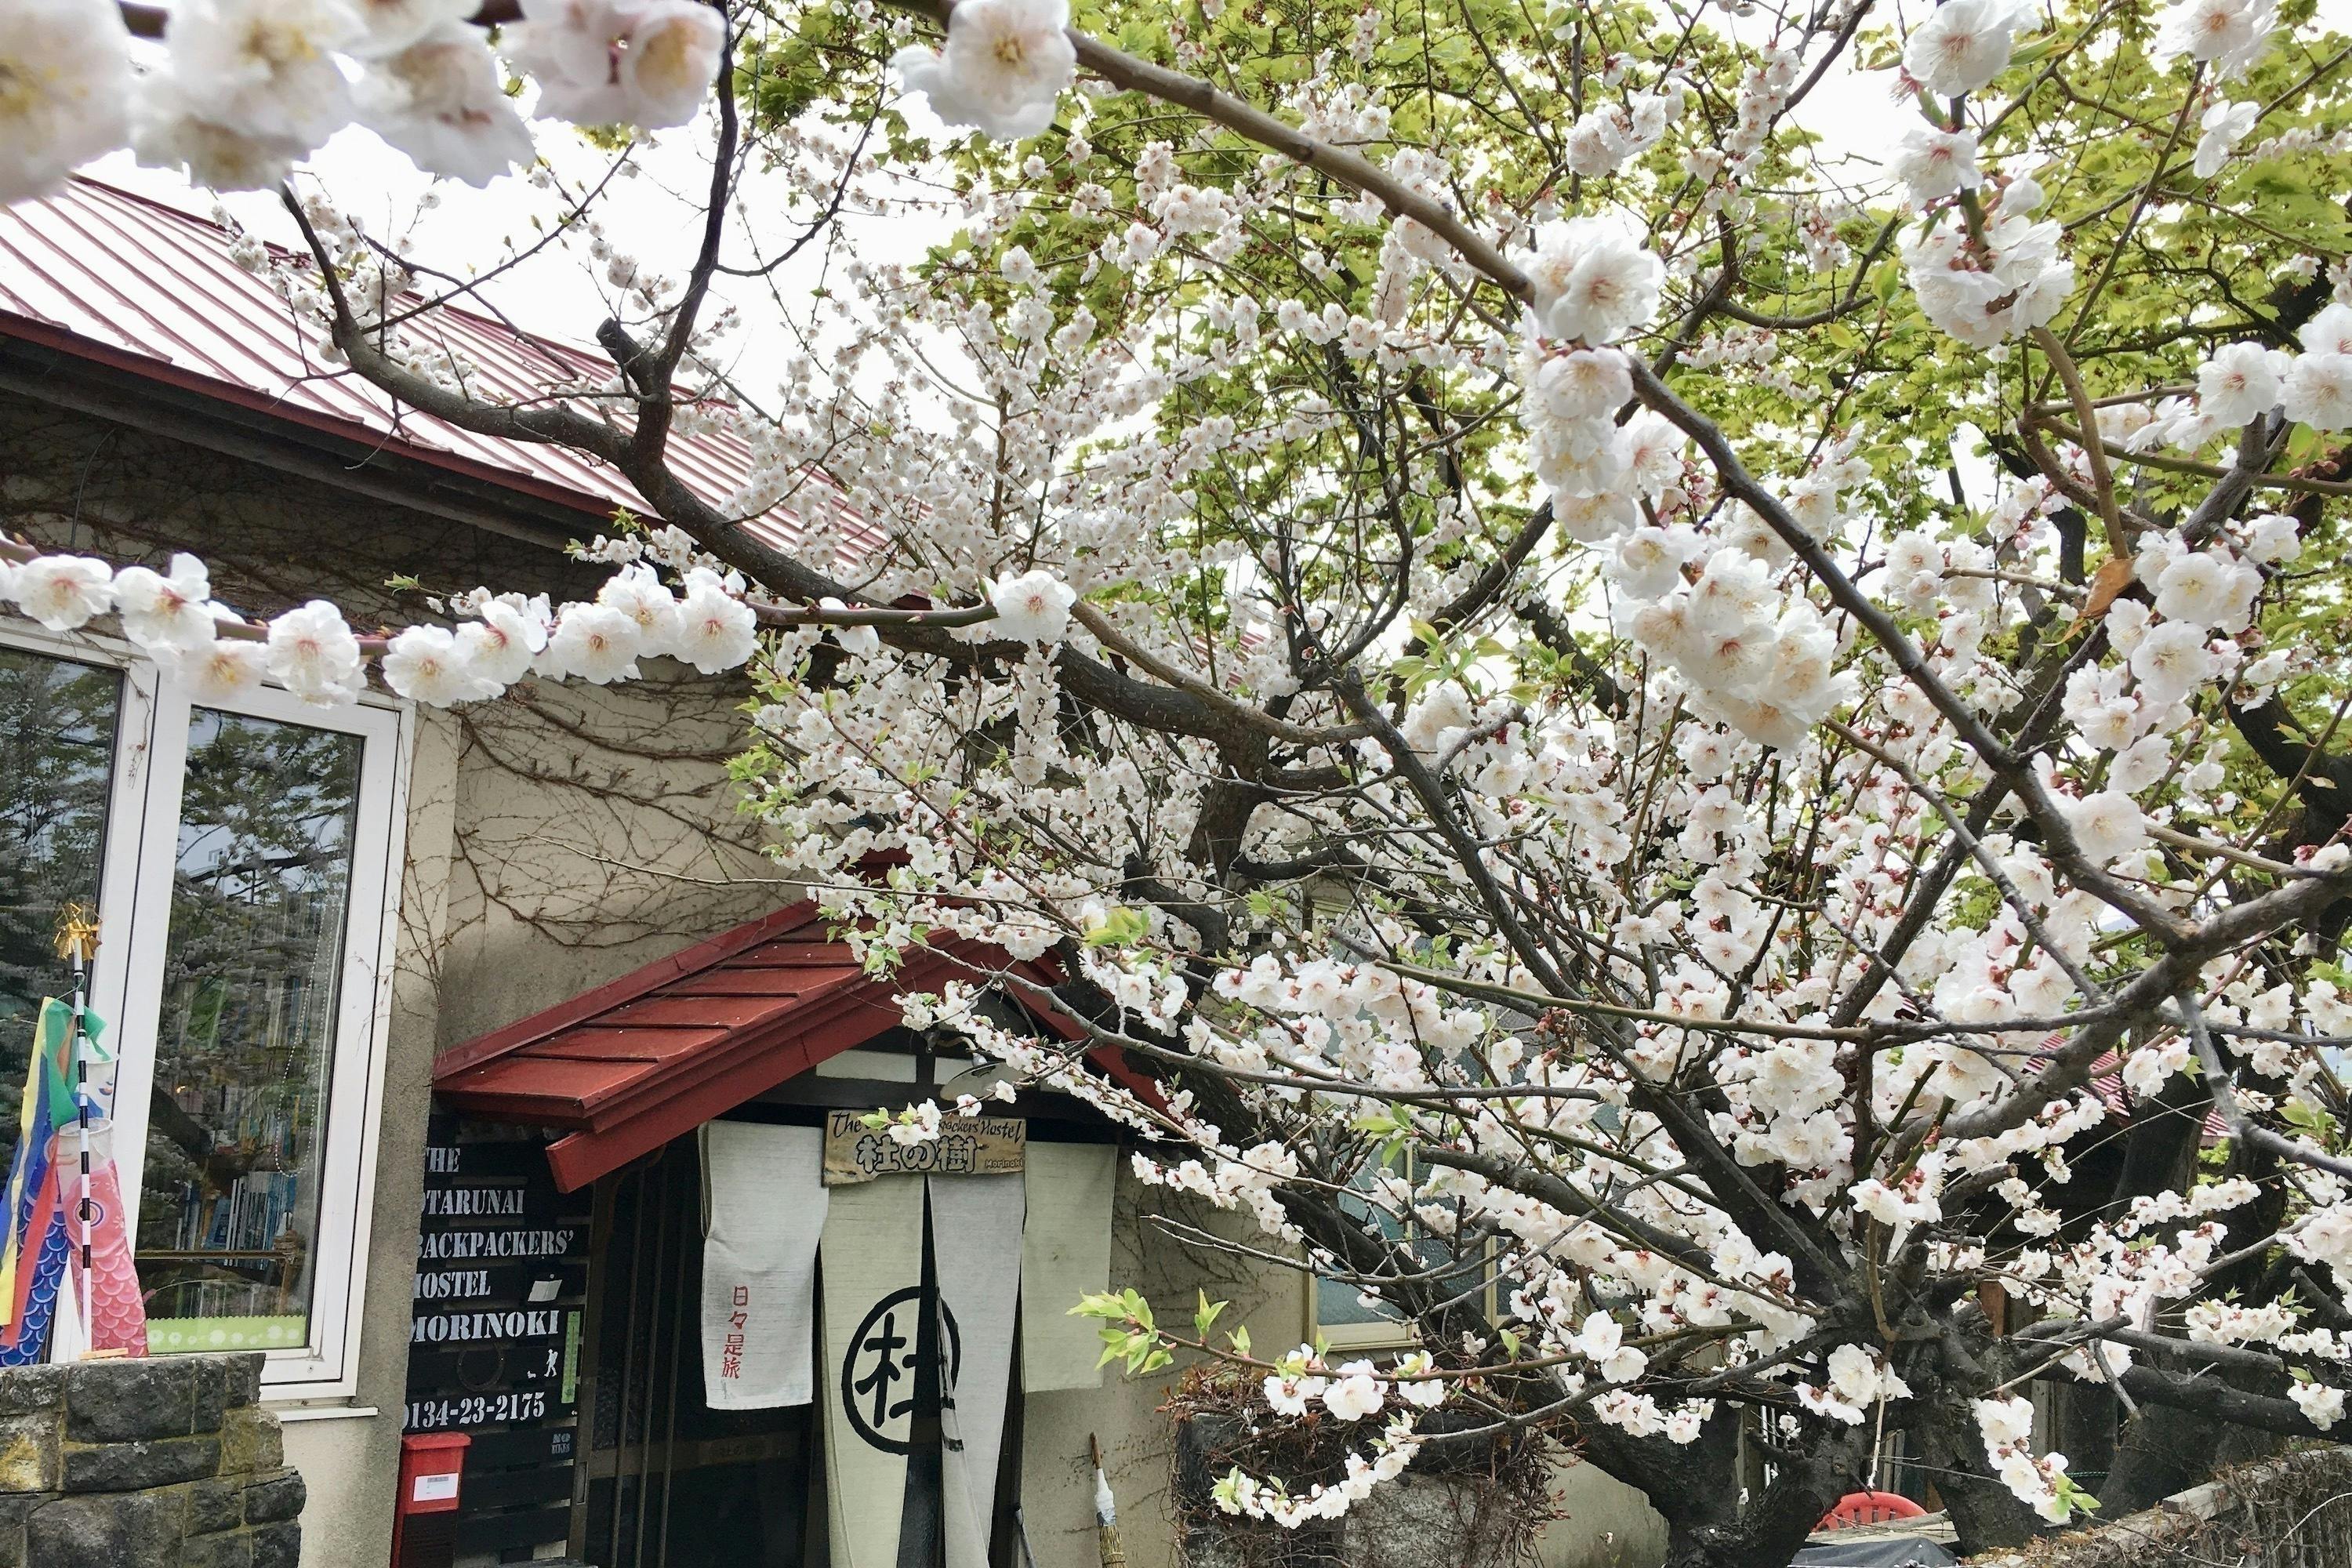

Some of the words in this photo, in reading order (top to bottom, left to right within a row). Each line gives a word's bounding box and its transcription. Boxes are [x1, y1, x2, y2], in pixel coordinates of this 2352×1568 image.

[832, 1112, 862, 1138] The
[981, 1119, 1022, 1144] Hostel
[426, 1148, 461, 1173] HE
[856, 1134, 978, 1174] 杜の樹
[985, 1158, 1024, 1169] Morinoki
[422, 1189, 525, 1215] TARUNAI
[721, 1285, 749, 1380] 日々是旅
